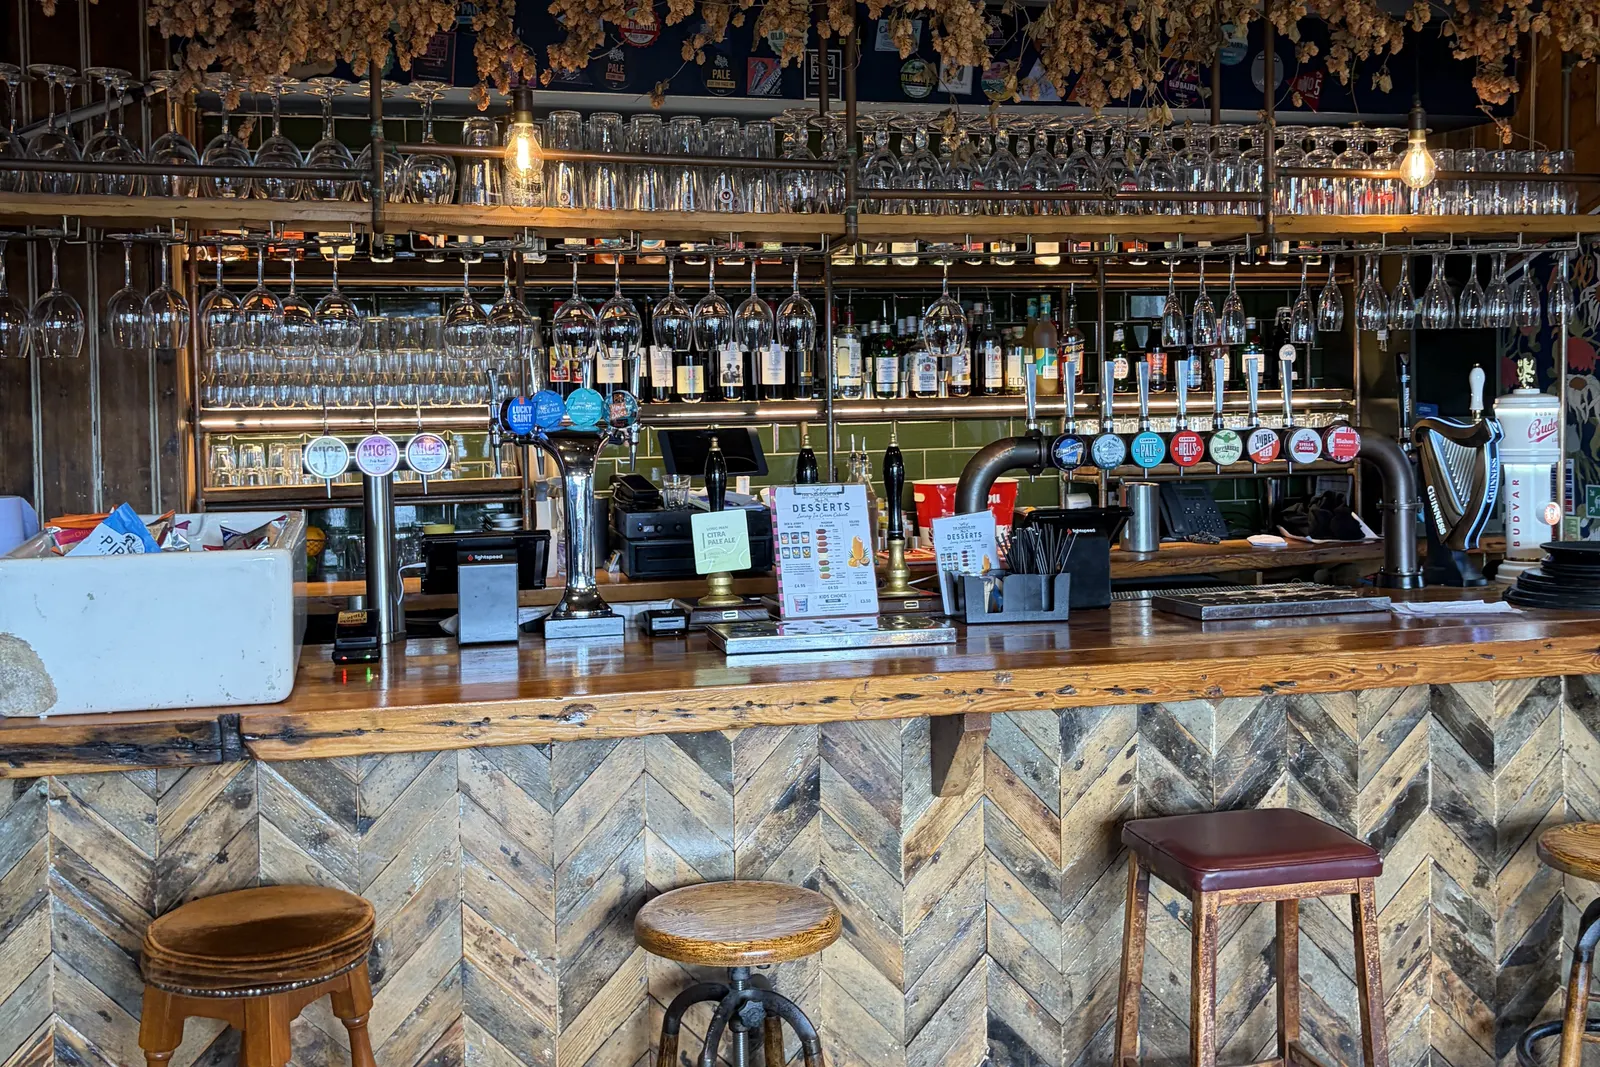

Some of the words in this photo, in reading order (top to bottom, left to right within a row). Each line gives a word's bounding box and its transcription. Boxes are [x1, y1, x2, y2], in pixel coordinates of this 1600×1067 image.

[607, 63, 624, 73] PALE
[712, 69, 731, 79] PALE
[1169, 80, 1180, 88] OLD
[1180, 82, 1197, 91] DAIRY
[1008, 377, 1026, 387] ELD
[512, 406, 532, 414] LUCKY
[512, 414, 532, 423] SAINT
[363, 443, 392, 457] NICE
[414, 441, 443, 456] NICE
[1140, 443, 1157, 457] PALE
[1179, 442, 1197, 456] HELLS
[1486, 457, 1498, 504] GUINNESS
[792, 502, 851, 513] DESSERTS
[1427, 485, 1447, 536] GUINNESS
[1512, 479, 1521, 547] BUDVAR
[707, 531, 726, 539] CITRA
[946, 531, 983, 541] DESSERTS
[100, 535, 125, 555] PIP
